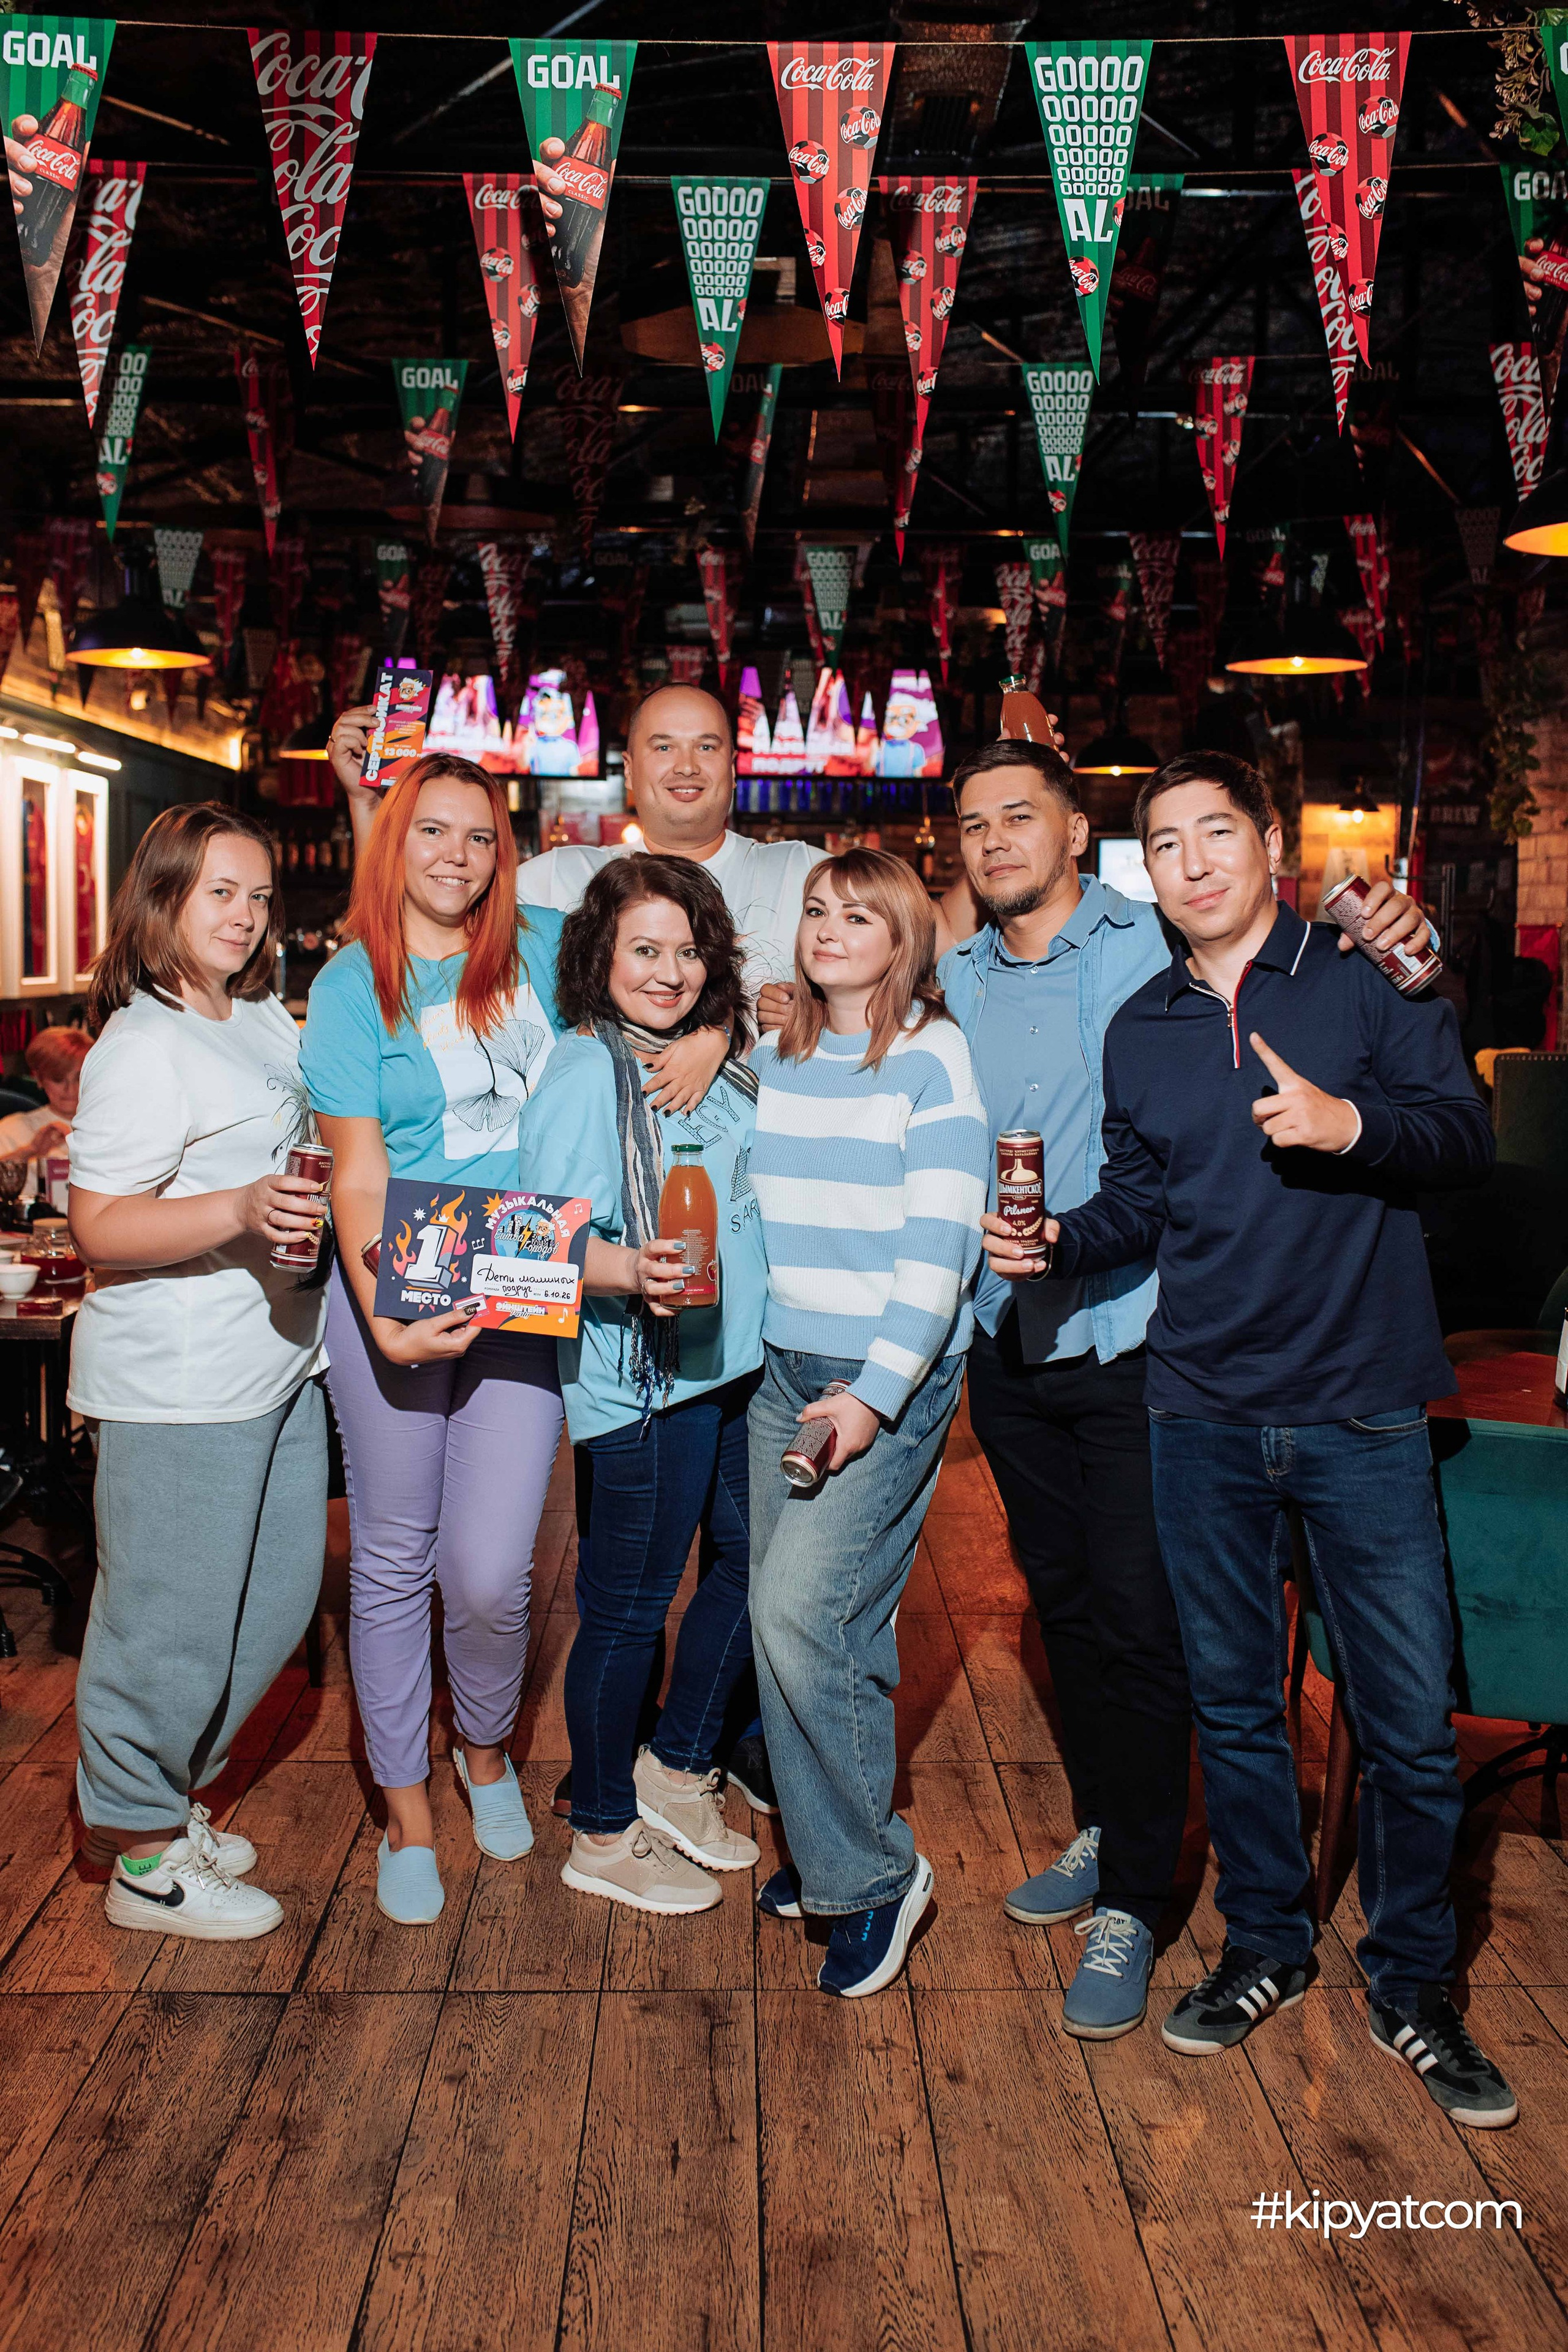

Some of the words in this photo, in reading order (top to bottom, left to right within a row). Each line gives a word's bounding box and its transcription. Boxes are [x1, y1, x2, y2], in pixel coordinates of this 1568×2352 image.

[3, 31, 97, 70] GOAL
[527, 55, 620, 89] GOAL
[781, 57, 880, 91] Coca-Cola
[1035, 56, 1144, 91] GOOOO
[1298, 48, 1396, 83] Coca-Cola
[39, 168, 61, 180] CLASSIC
[554, 162, 608, 199] Coca-Cola
[568, 189, 589, 201] CLASSIC
[677, 186, 764, 217] GOOOO
[1063, 198, 1113, 241] AL
[697, 298, 737, 331] AL
[401, 368, 459, 389] GOAL
[1027, 371, 1093, 393] GOOOO
[1044, 456, 1076, 481] AL
[998, 1182, 1041, 1194] ШЫМКЕНТСКОЕ
[485, 1196, 570, 1238] МУЗЫКАЛЬНАЯ
[1003, 1204, 1036, 1216] Pilsner
[404, 1225, 448, 1283] 1
[478, 1263, 514, 1283] Дети
[401, 1290, 451, 1306] МЕСТО
[502, 1285, 532, 1298] подруг
[544, 1290, 571, 1299] 6.10.26
[496, 1301, 545, 1315] ЭЙНШТЕЙН
[510, 1309, 531, 1319] Party
